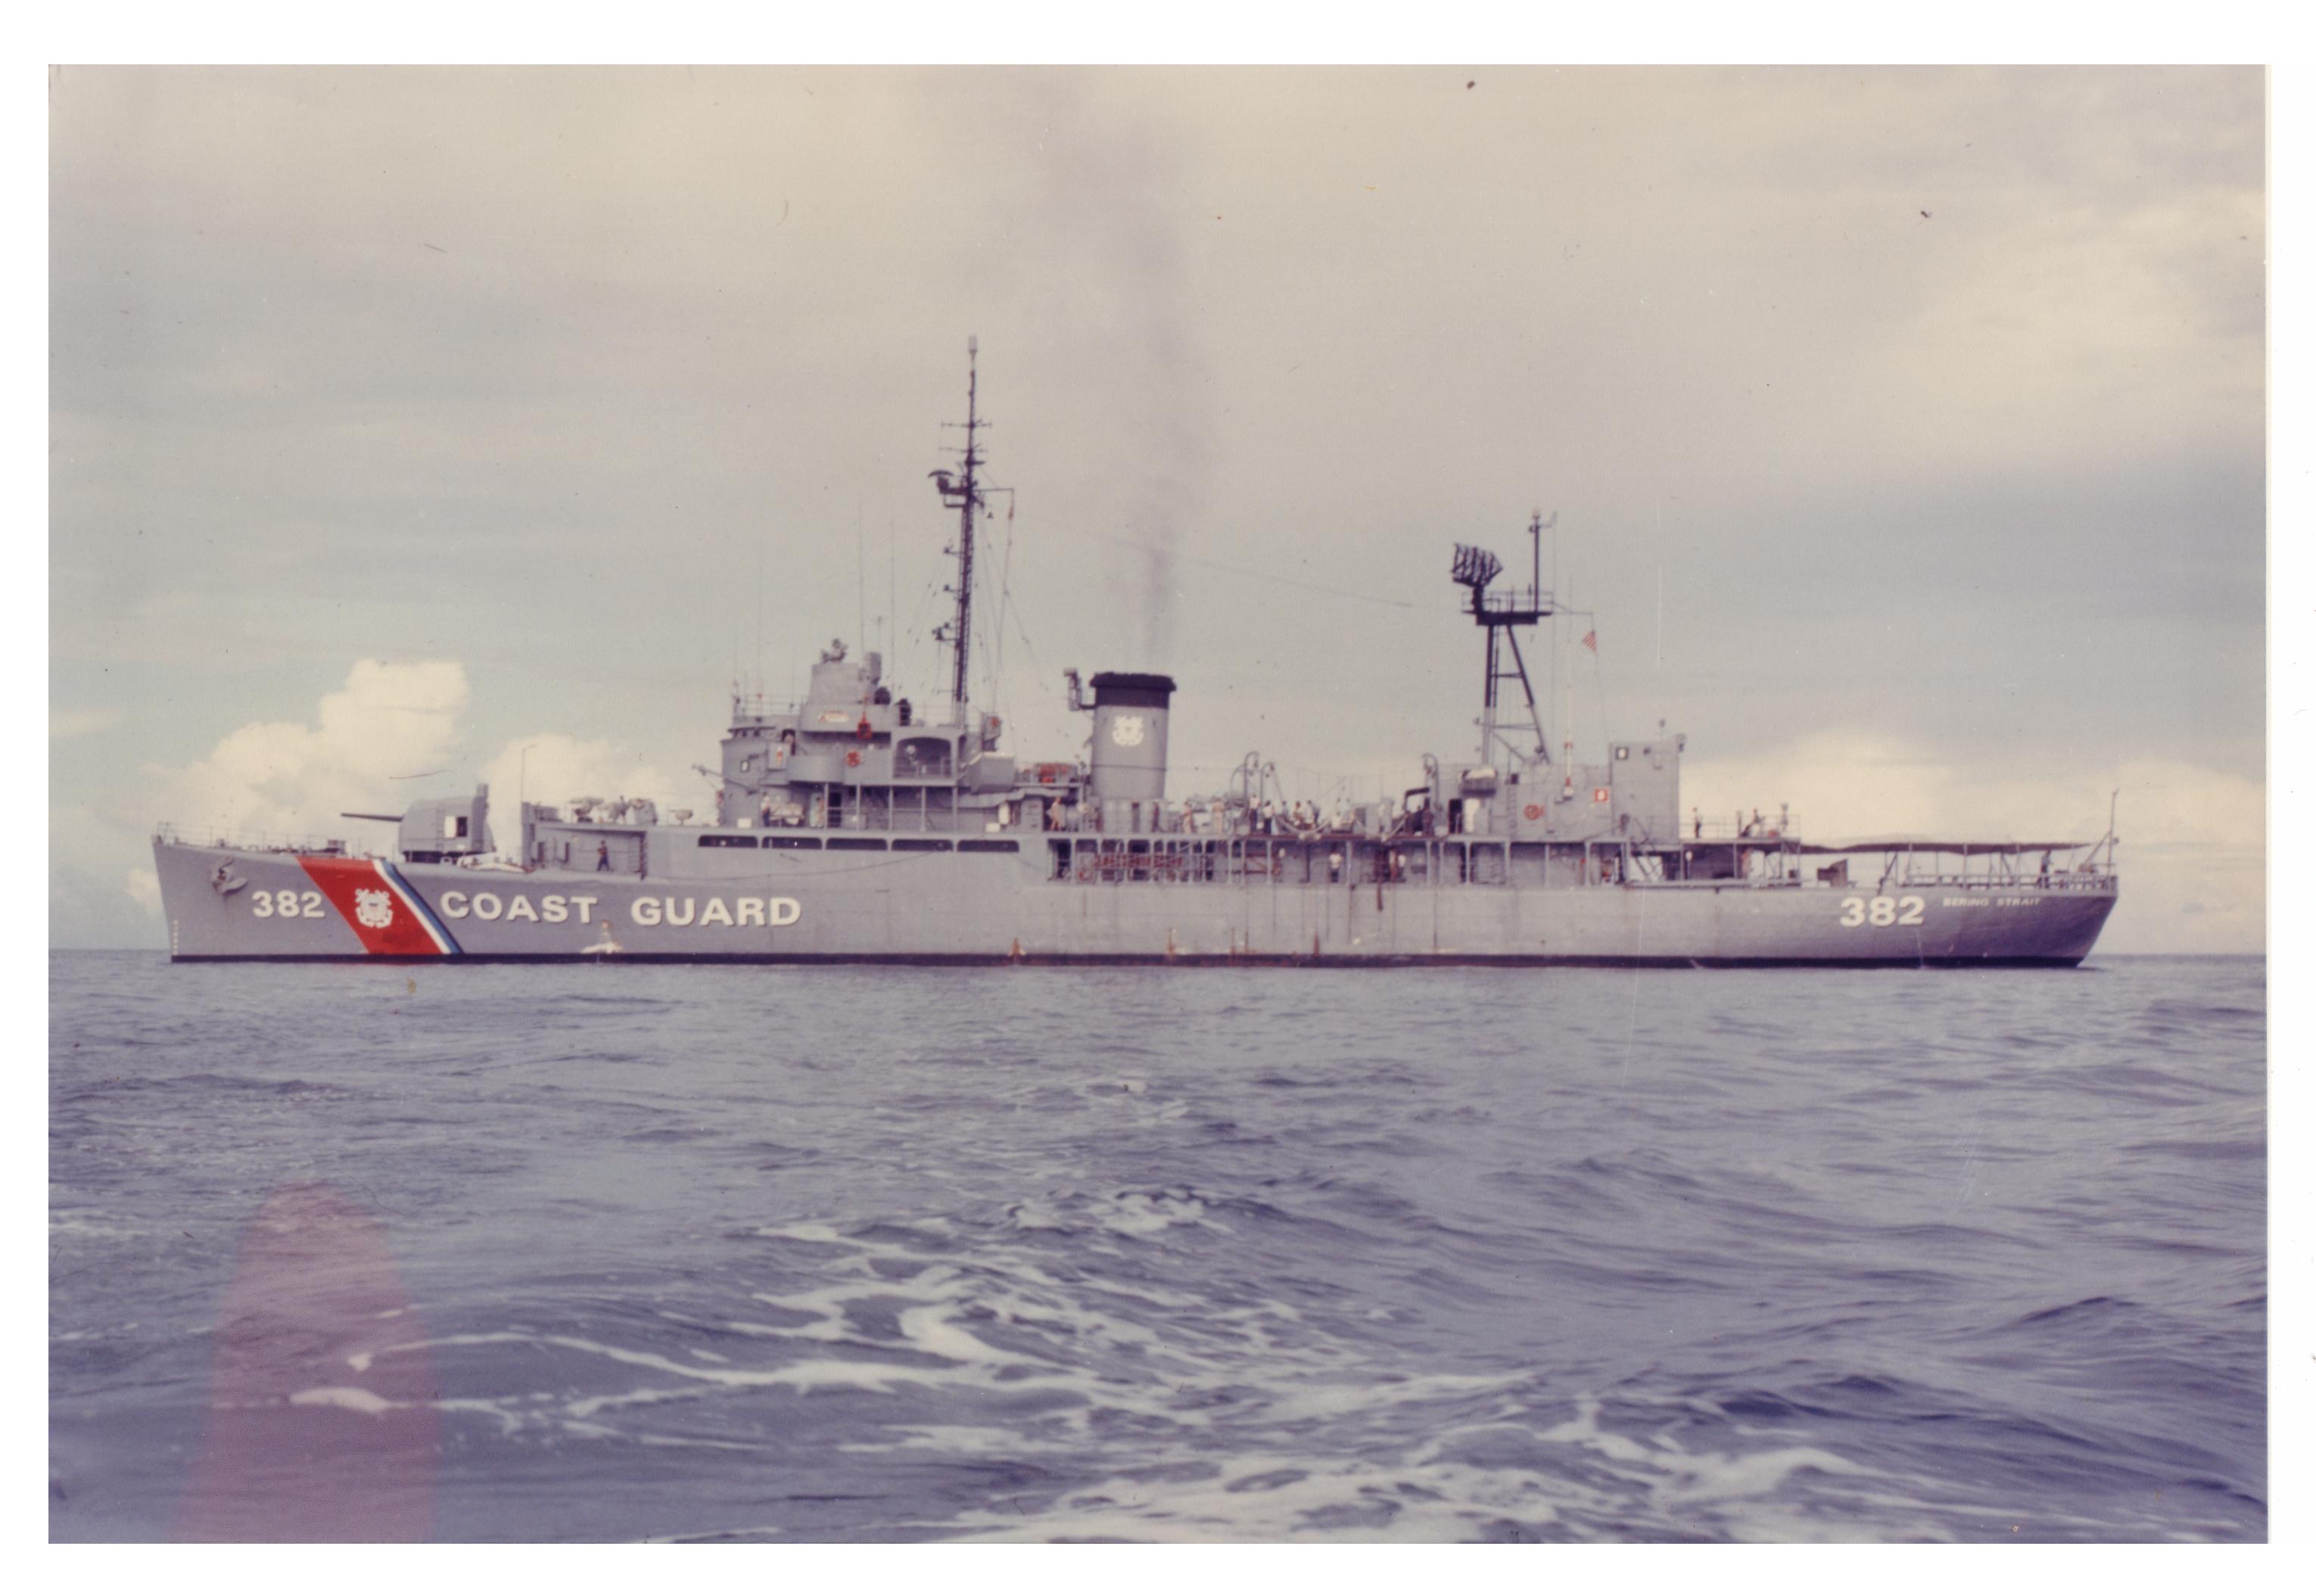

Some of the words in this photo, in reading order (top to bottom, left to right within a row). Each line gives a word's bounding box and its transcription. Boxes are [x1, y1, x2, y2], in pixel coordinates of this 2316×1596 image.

[252, 890, 325, 918] 382
[440, 891, 598, 924] COAST
[630, 896, 802, 926] GUARD
[1839, 895, 1925, 927] 382
[1942, 897, 1990, 907] BERING
[1996, 897, 2042, 907] STRAIT
